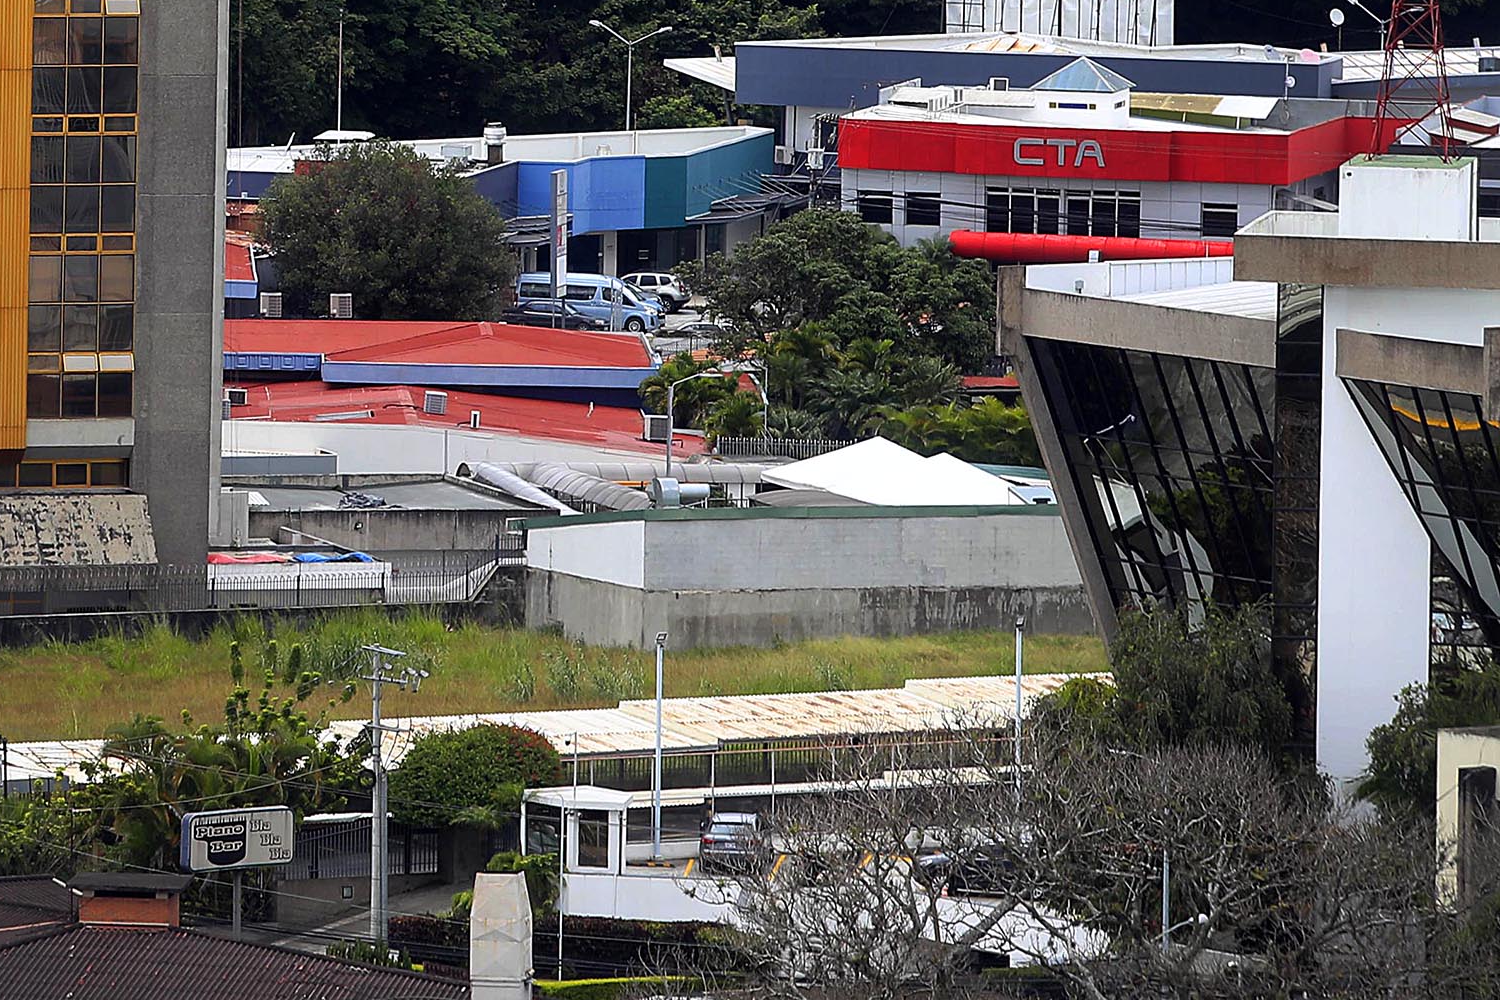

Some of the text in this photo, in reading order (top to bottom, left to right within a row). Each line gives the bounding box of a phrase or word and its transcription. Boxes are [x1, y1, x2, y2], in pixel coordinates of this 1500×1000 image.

[1014, 137, 1105, 168] CTA
[196, 825, 244, 838] Piano
[250, 820, 272, 832] Bla
[261, 833, 282, 846] Bla
[211, 841, 243, 853] Bar
[269, 847, 291, 860] Bla
